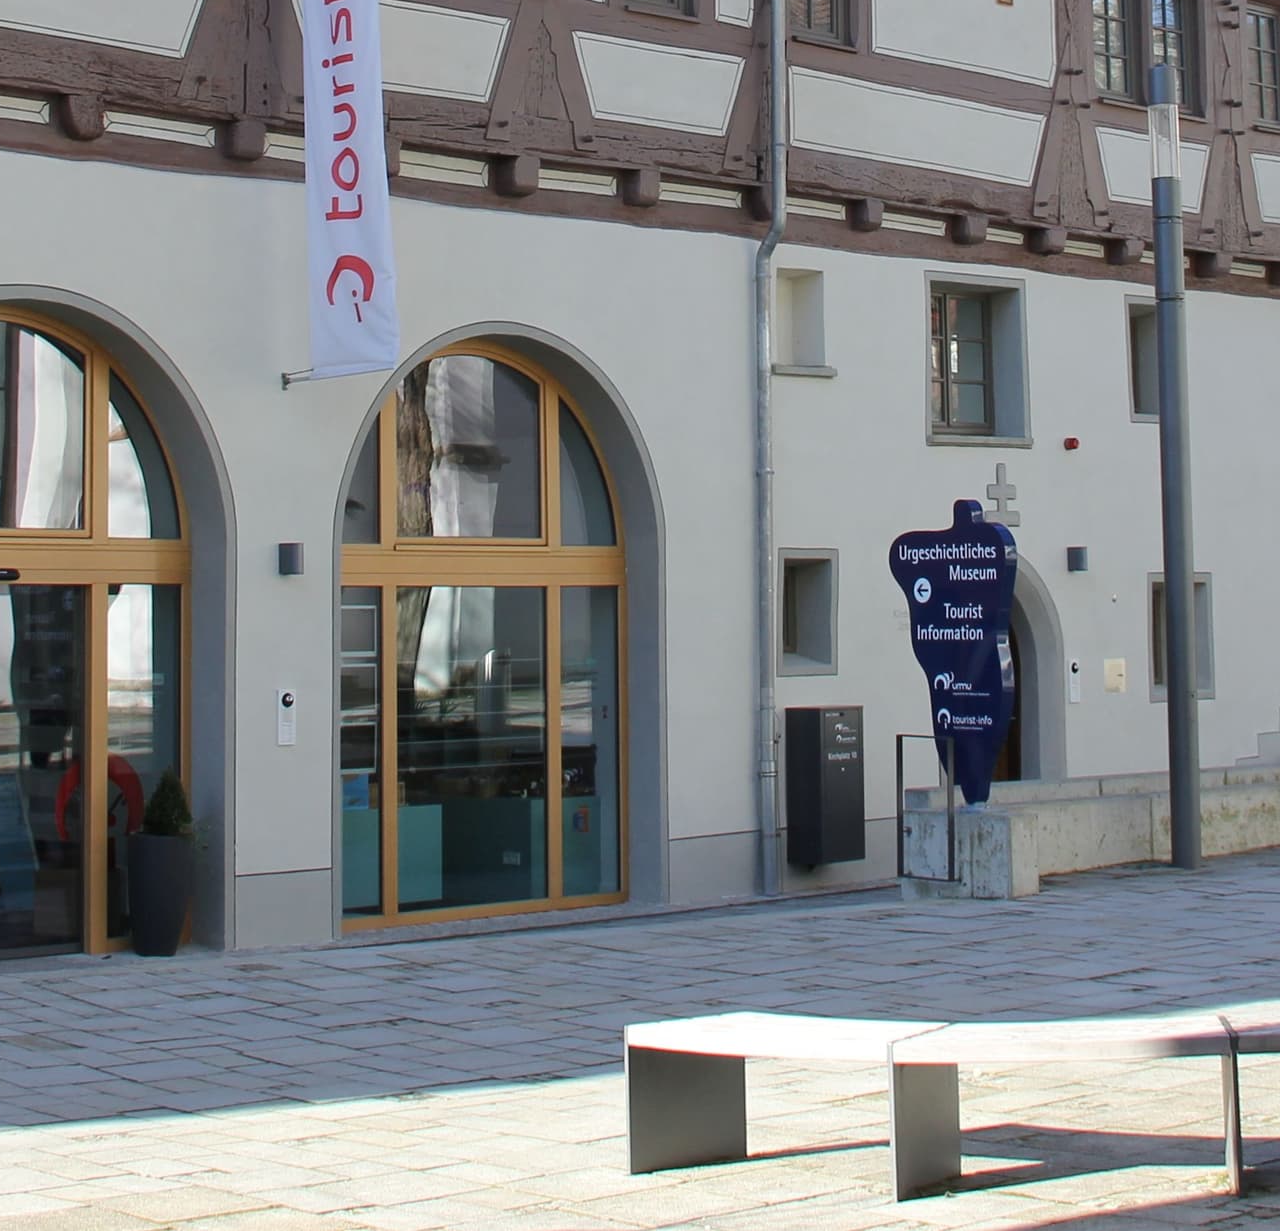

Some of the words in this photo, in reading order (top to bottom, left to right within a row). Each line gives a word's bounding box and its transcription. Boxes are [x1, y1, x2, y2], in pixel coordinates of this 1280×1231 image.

[898, 543, 997, 565] Urgeschichtliches
[949, 564, 997, 581] Museum
[943, 603, 983, 619] Tourist
[917, 624, 984, 641] Information
[952, 715, 993, 725] tourist-info
